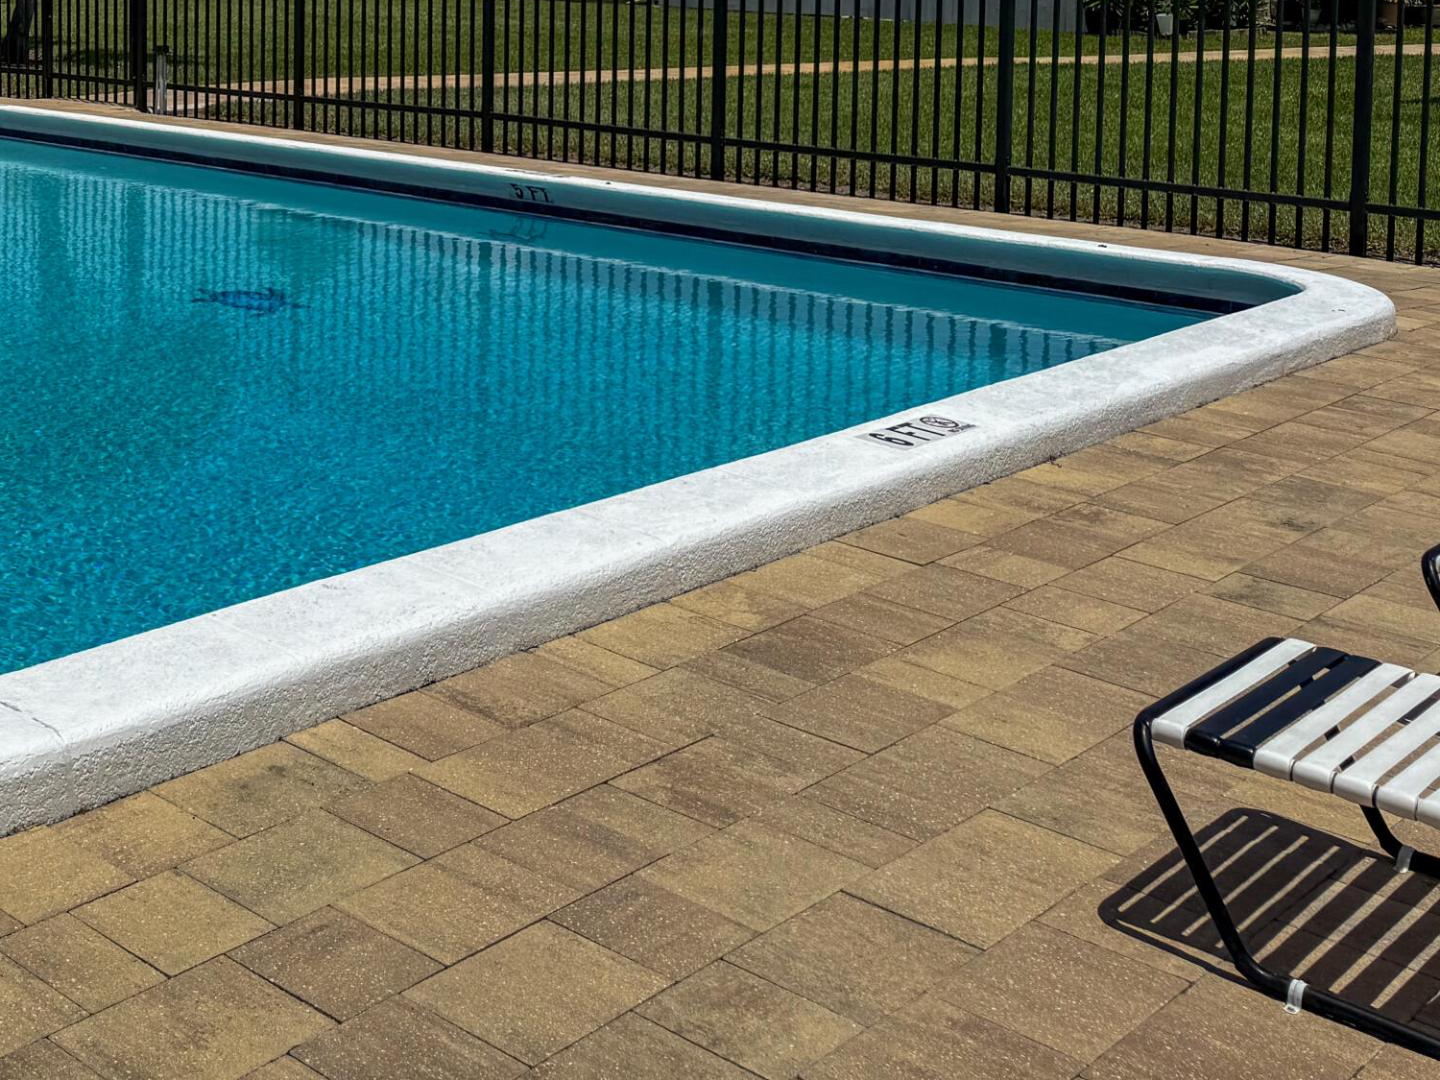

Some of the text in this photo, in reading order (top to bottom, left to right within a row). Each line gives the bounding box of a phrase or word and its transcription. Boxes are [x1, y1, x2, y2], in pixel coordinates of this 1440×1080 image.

[525, 185, 550, 203] FT
[868, 432, 915, 447] 6
[885, 422, 947, 442] FT
